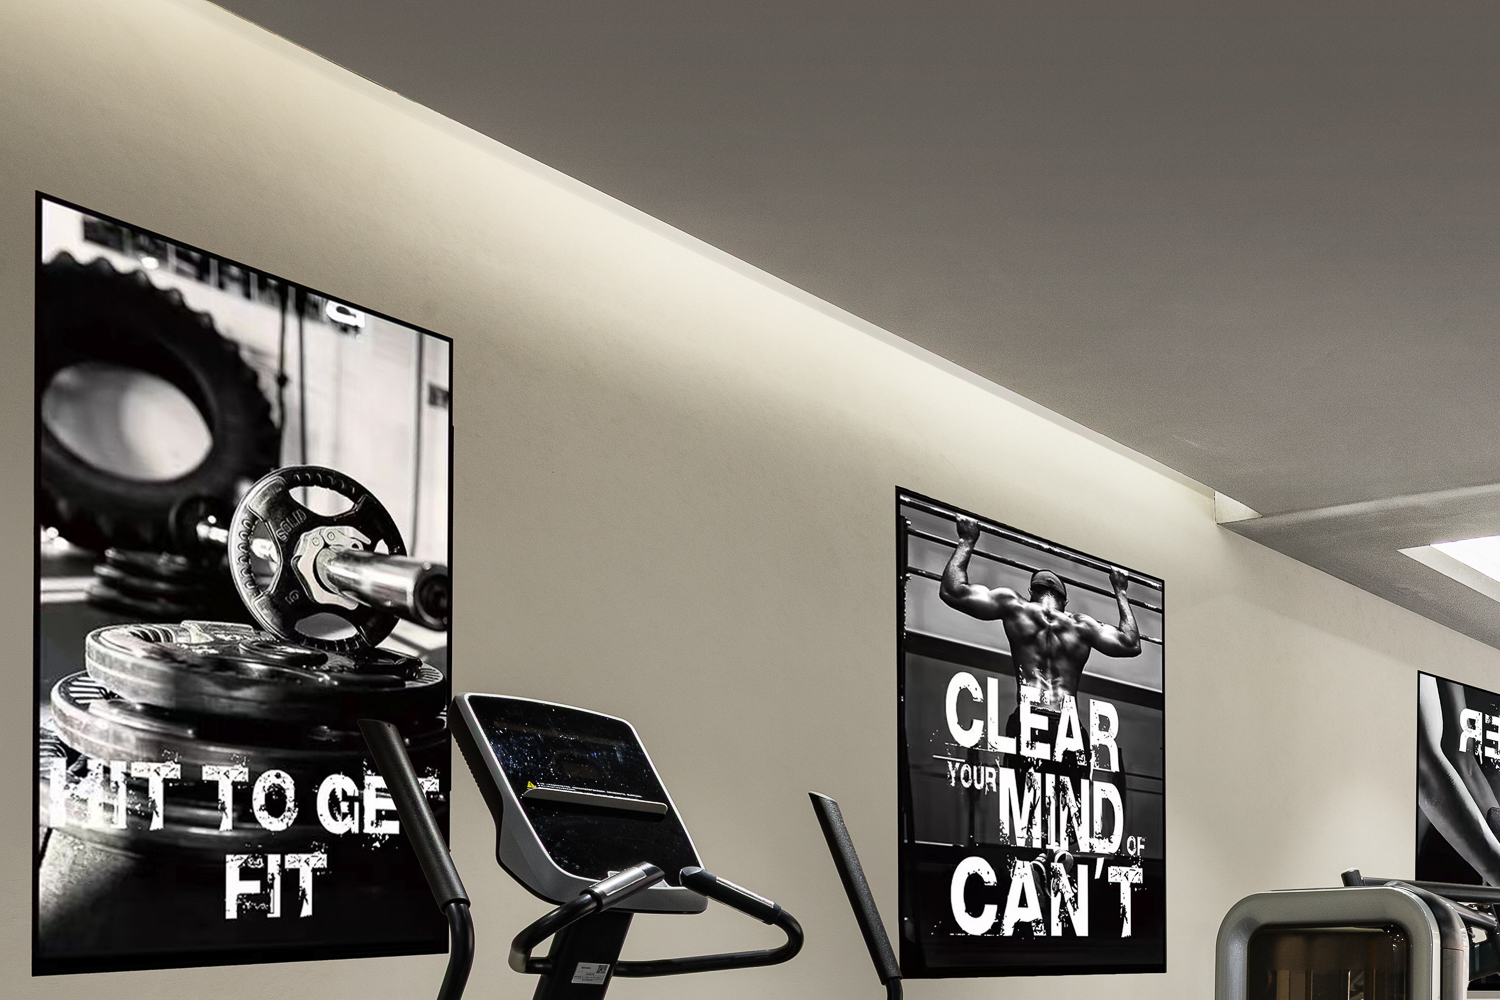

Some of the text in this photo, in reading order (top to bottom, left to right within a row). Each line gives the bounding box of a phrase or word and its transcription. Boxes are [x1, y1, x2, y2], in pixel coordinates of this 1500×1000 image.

[945, 672, 1120, 773] CLEAR
[49, 757, 182, 831] HIT
[202, 765, 296, 831] TO
[947, 758, 1147, 856] YOUR MIND OF
[225, 853, 328, 919] FIT
[950, 856, 1144, 938] CAN'T
